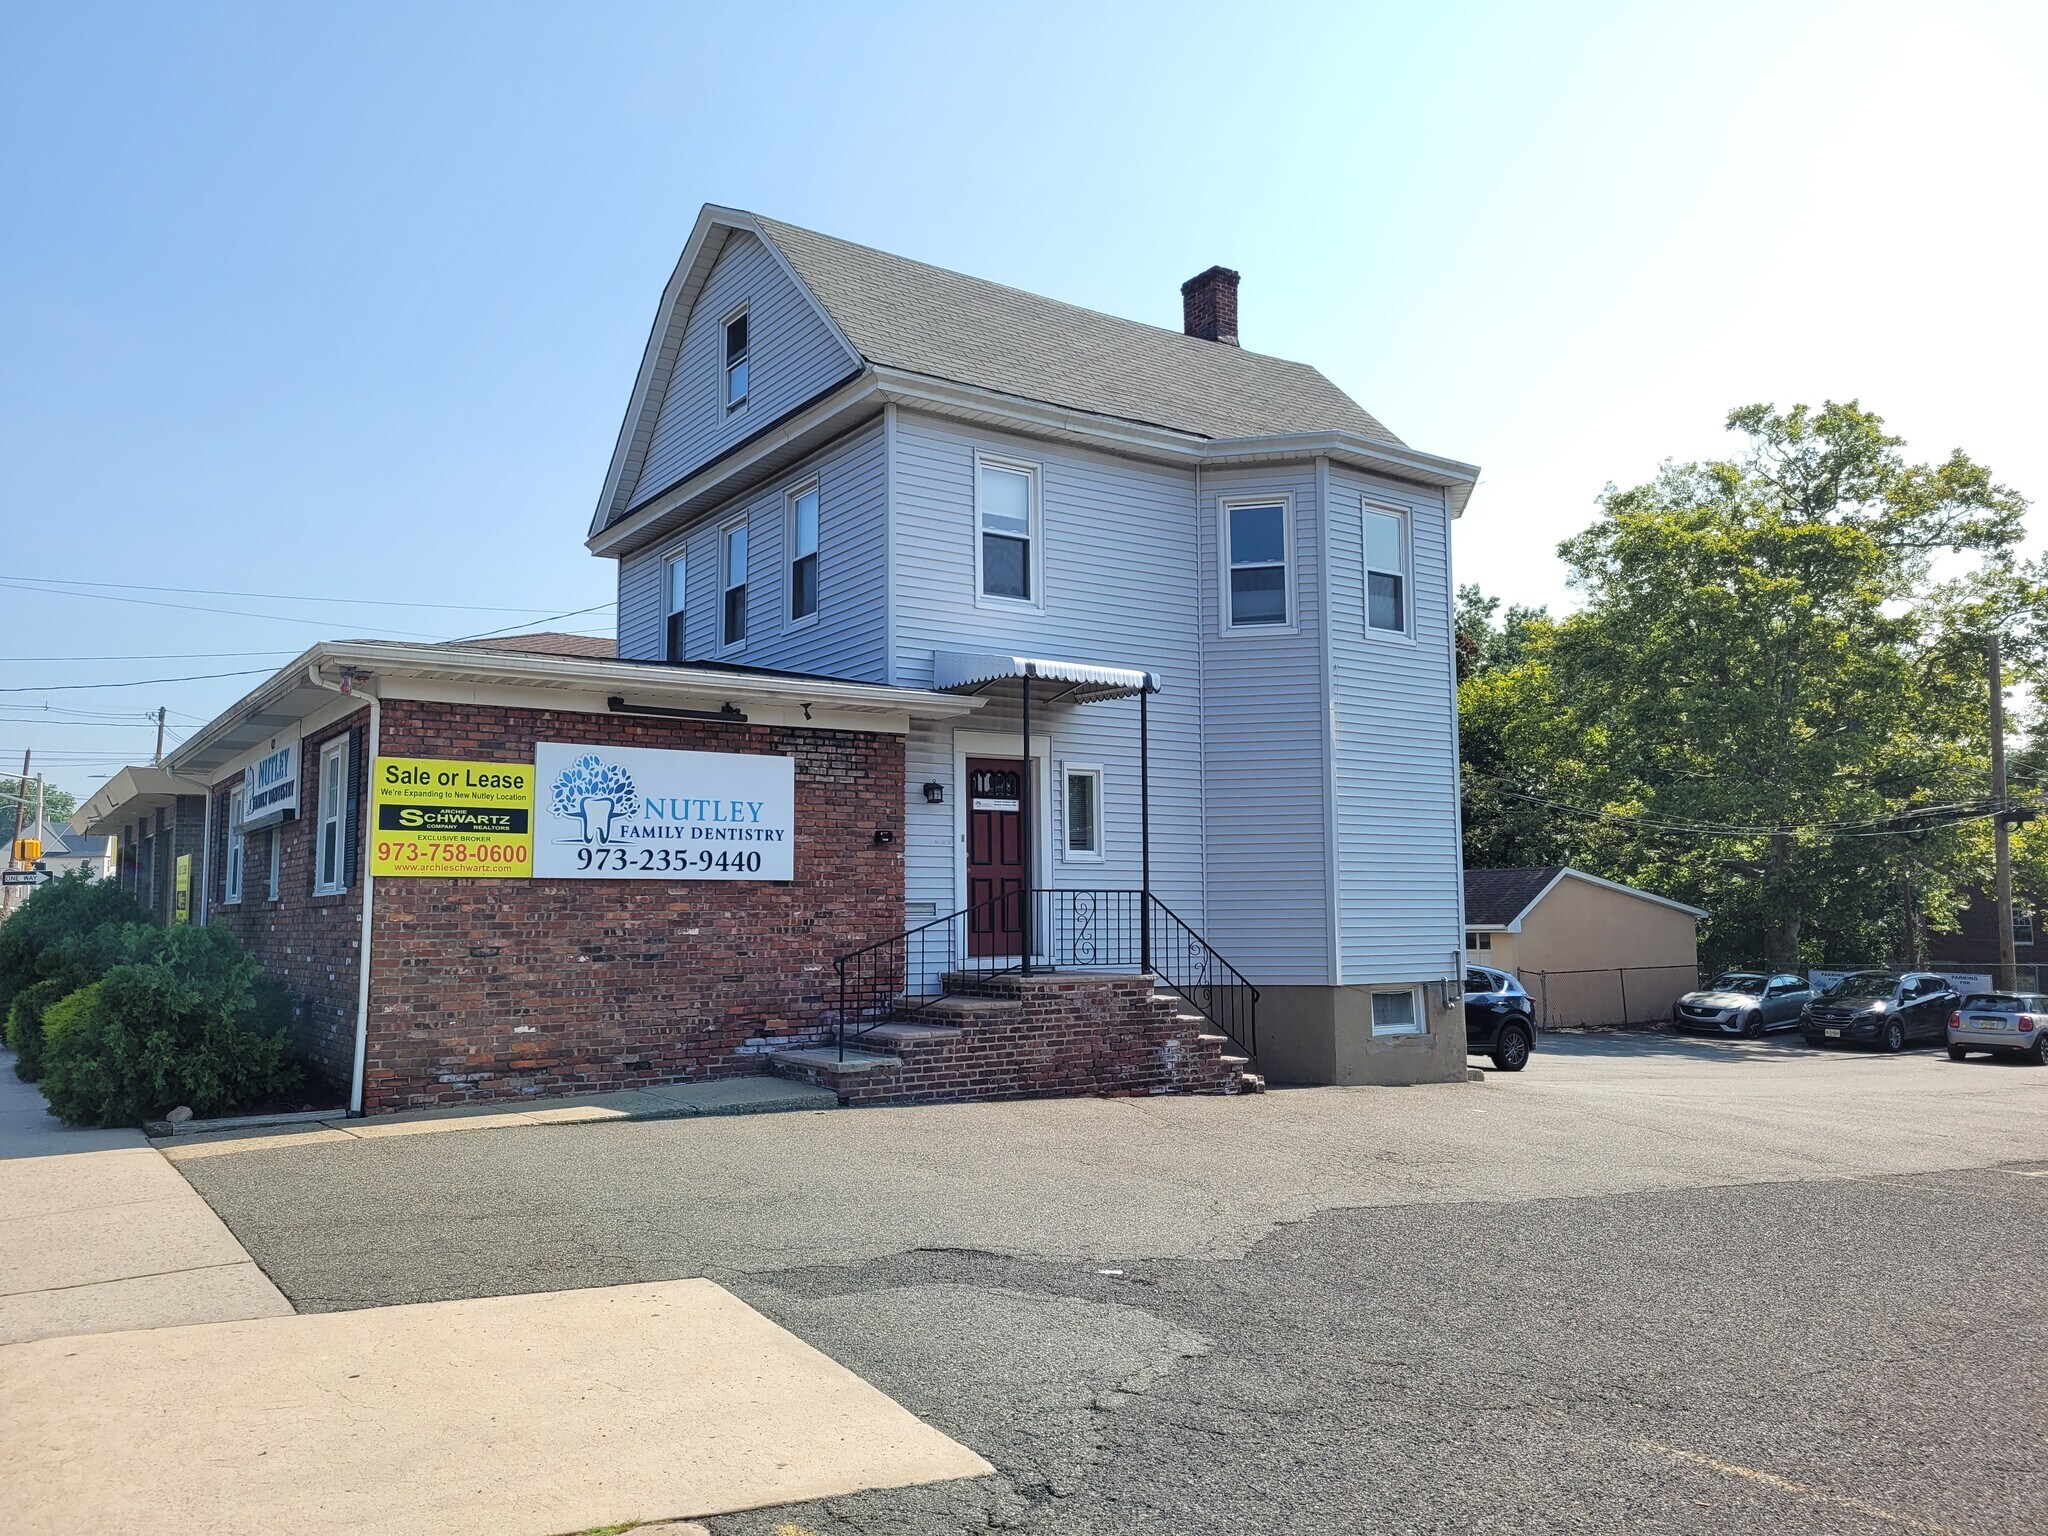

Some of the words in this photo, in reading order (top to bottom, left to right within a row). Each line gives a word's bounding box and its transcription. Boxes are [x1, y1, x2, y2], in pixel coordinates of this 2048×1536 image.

[258, 747, 290, 789] NUTLEY
[385, 765, 431, 785] Sale
[437, 771, 459, 787] or
[465, 769, 524, 789] Lease
[380, 788, 402, 796] We're
[404, 789, 443, 799] Expanding
[454, 791, 470, 799] New
[471, 792, 494, 801] Nutley
[496, 793, 527, 801] Location
[399, 808, 511, 827] SCHWARTZ
[643, 797, 765, 823] NUTLEY
[417, 834, 459, 842] EXCLUSIVE
[620, 825, 685, 839] FAMILY
[691, 827, 785, 842] DENTISTRY
[377, 842, 527, 863] 973-758-0600
[577, 848, 762, 872] 973-235-9440
[394, 863, 512, 873] www.archieschwartz.com
